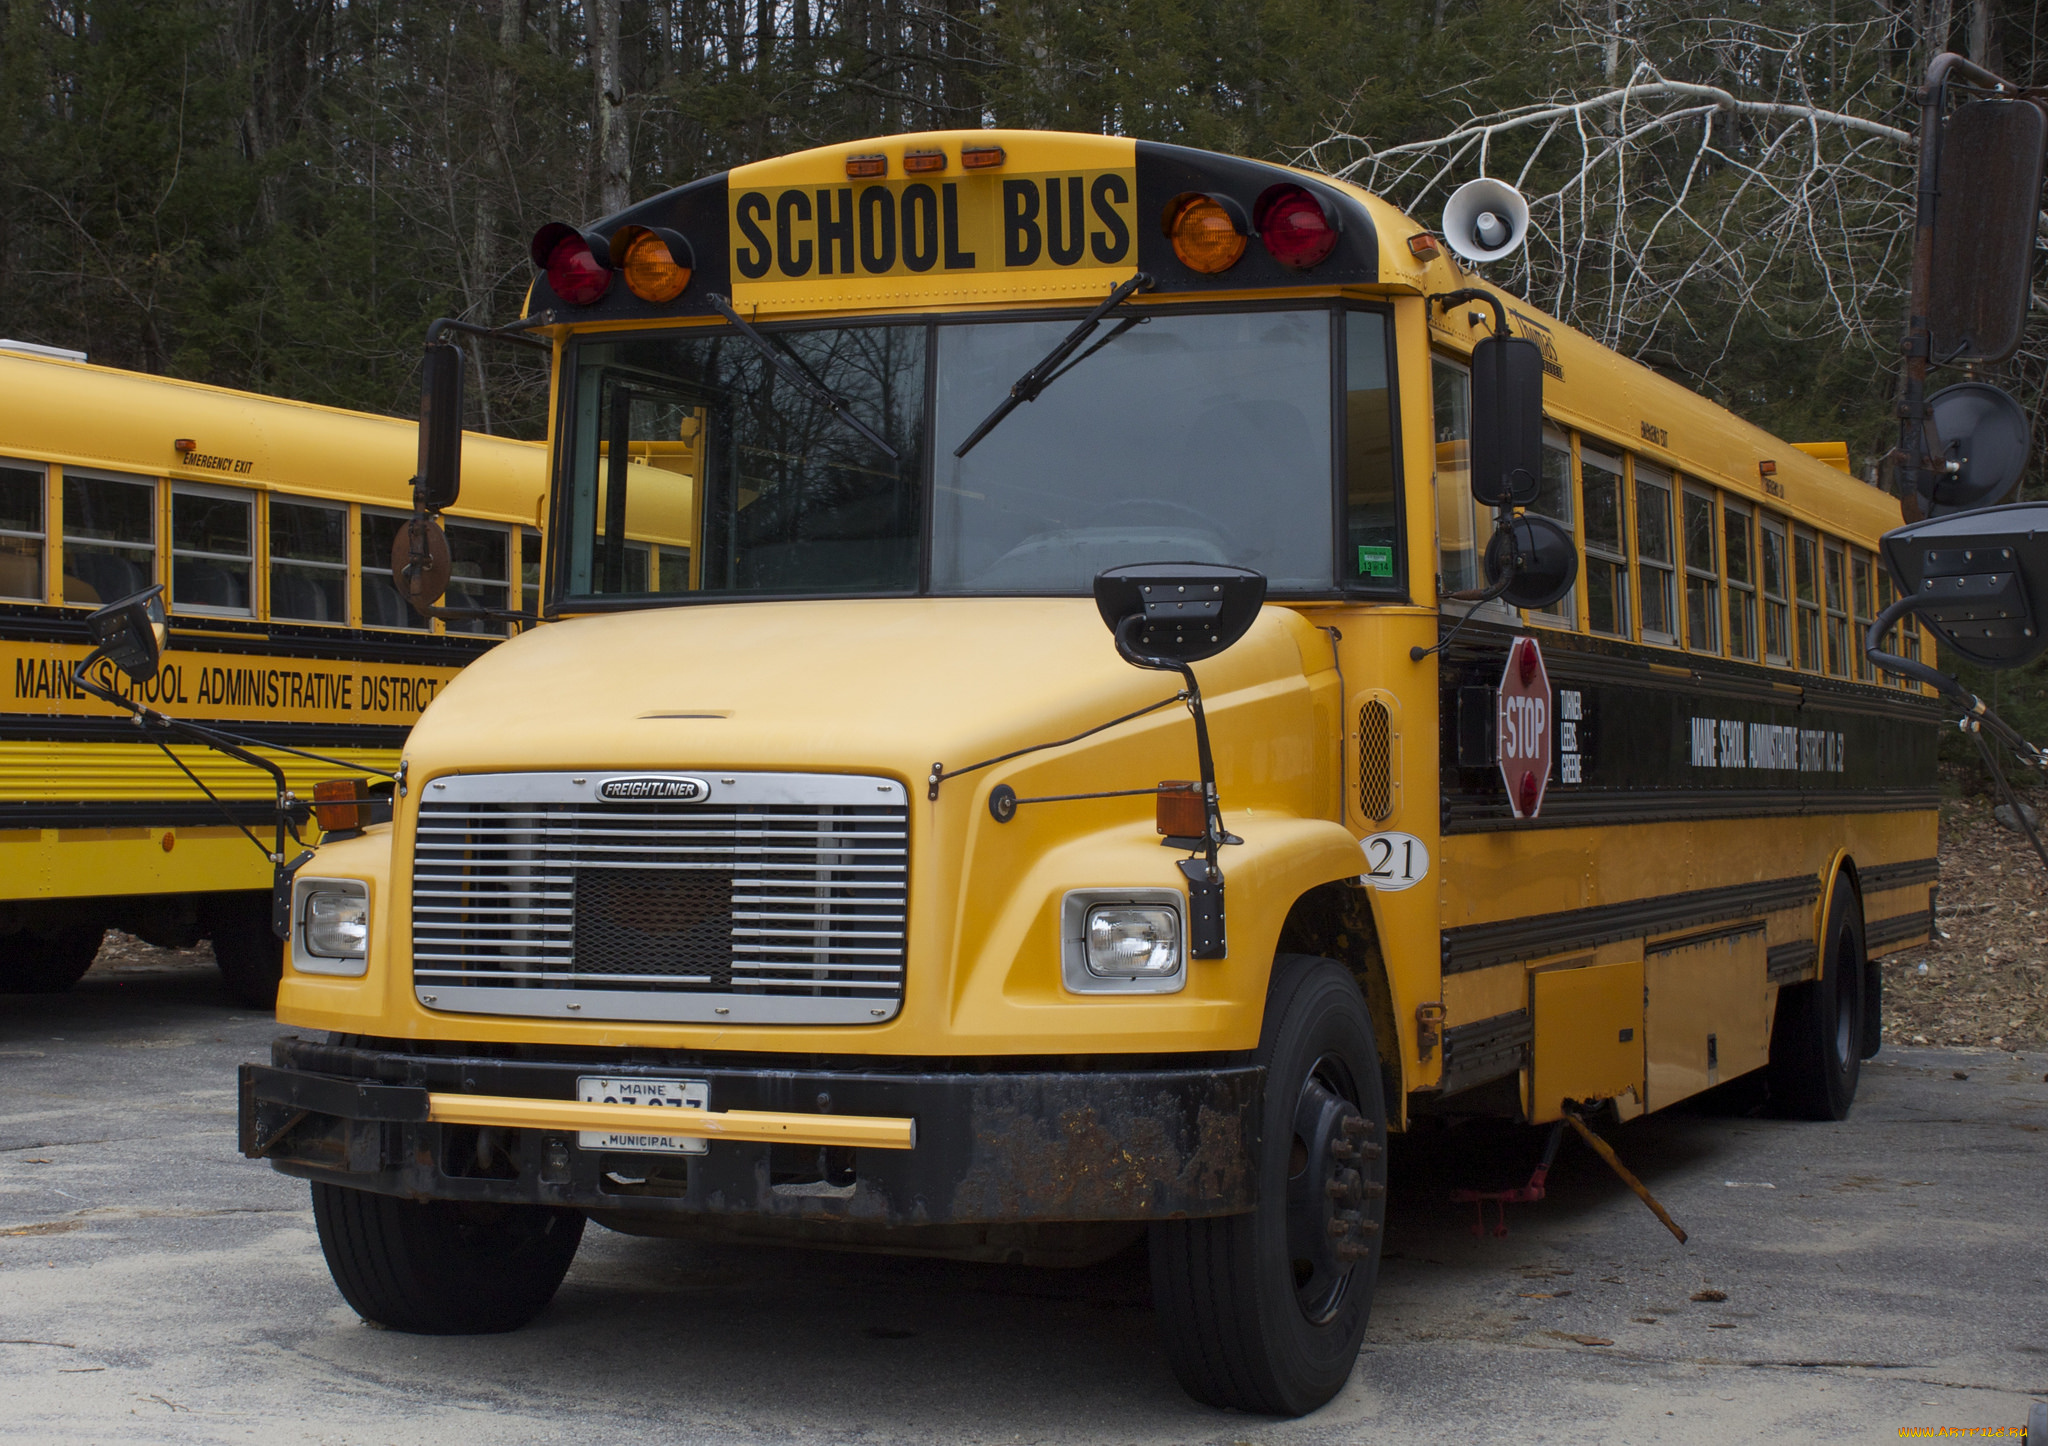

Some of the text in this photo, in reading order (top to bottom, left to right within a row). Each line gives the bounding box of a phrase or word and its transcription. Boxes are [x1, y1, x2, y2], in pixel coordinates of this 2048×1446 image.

[736, 174, 1130, 279] SCHOOL BUS
[183, 452, 253, 474] EMERGENCY EXIT
[15, 658, 86, 699] MAINE
[197, 667, 353, 709] ADMINISTRATIVE
[361, 676, 437, 713] DISTRICT
[1507, 696, 1545, 758] STOP
[1692, 717, 1716, 767] MAINE
[1720, 719, 1746, 768] SCHOOL
[1749, 722, 1798, 770] ADMINISTRATIVE
[1800, 730, 1825, 772] DISTRICT
[1561, 754, 1582, 783] GREENE
[605, 782, 695, 796] FREIGHTLINER
[1368, 838, 1415, 879] 21
[620, 1084, 666, 1095] MAINE
[609, 1135, 675, 1148] MUNICIPAL
